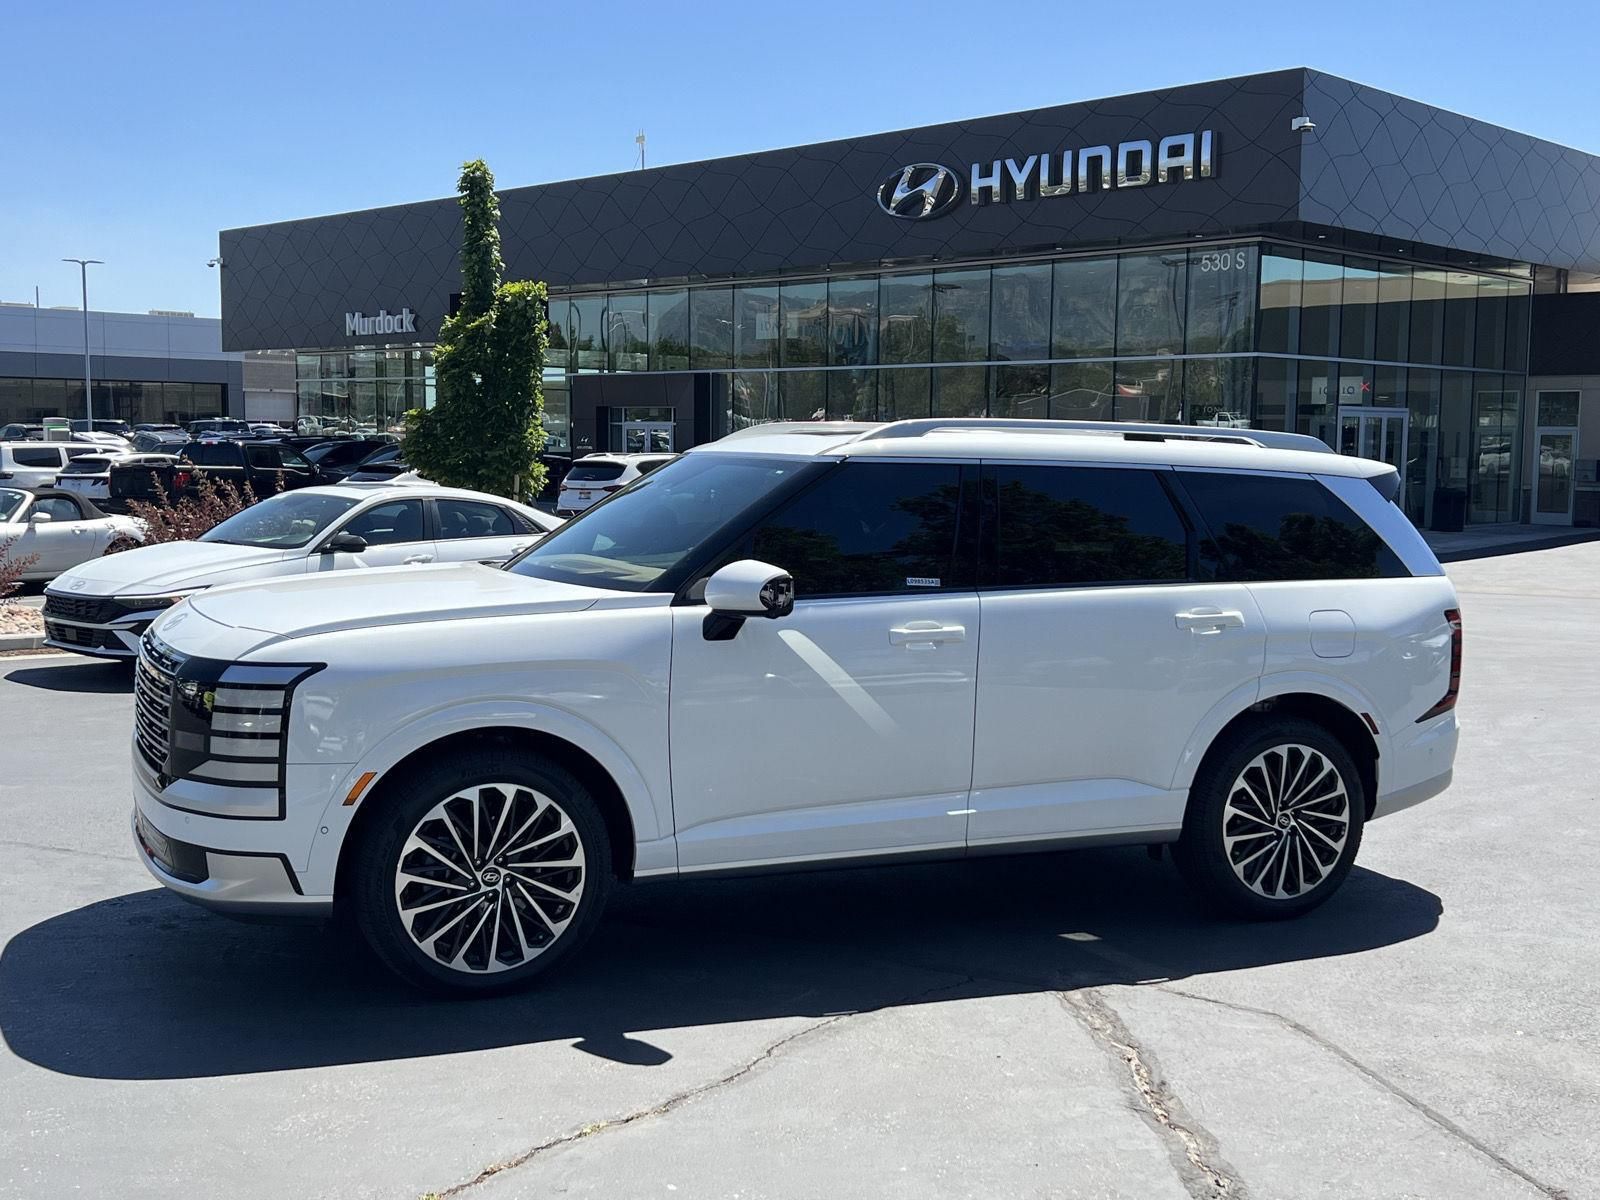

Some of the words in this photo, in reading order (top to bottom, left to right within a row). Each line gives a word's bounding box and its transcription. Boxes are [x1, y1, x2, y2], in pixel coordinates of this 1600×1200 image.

[970, 130, 1213, 205] HYUNDAI
[1200, 253, 1230, 272] 530
[1235, 251, 1246, 270] S
[345, 308, 417, 336] Murdock
